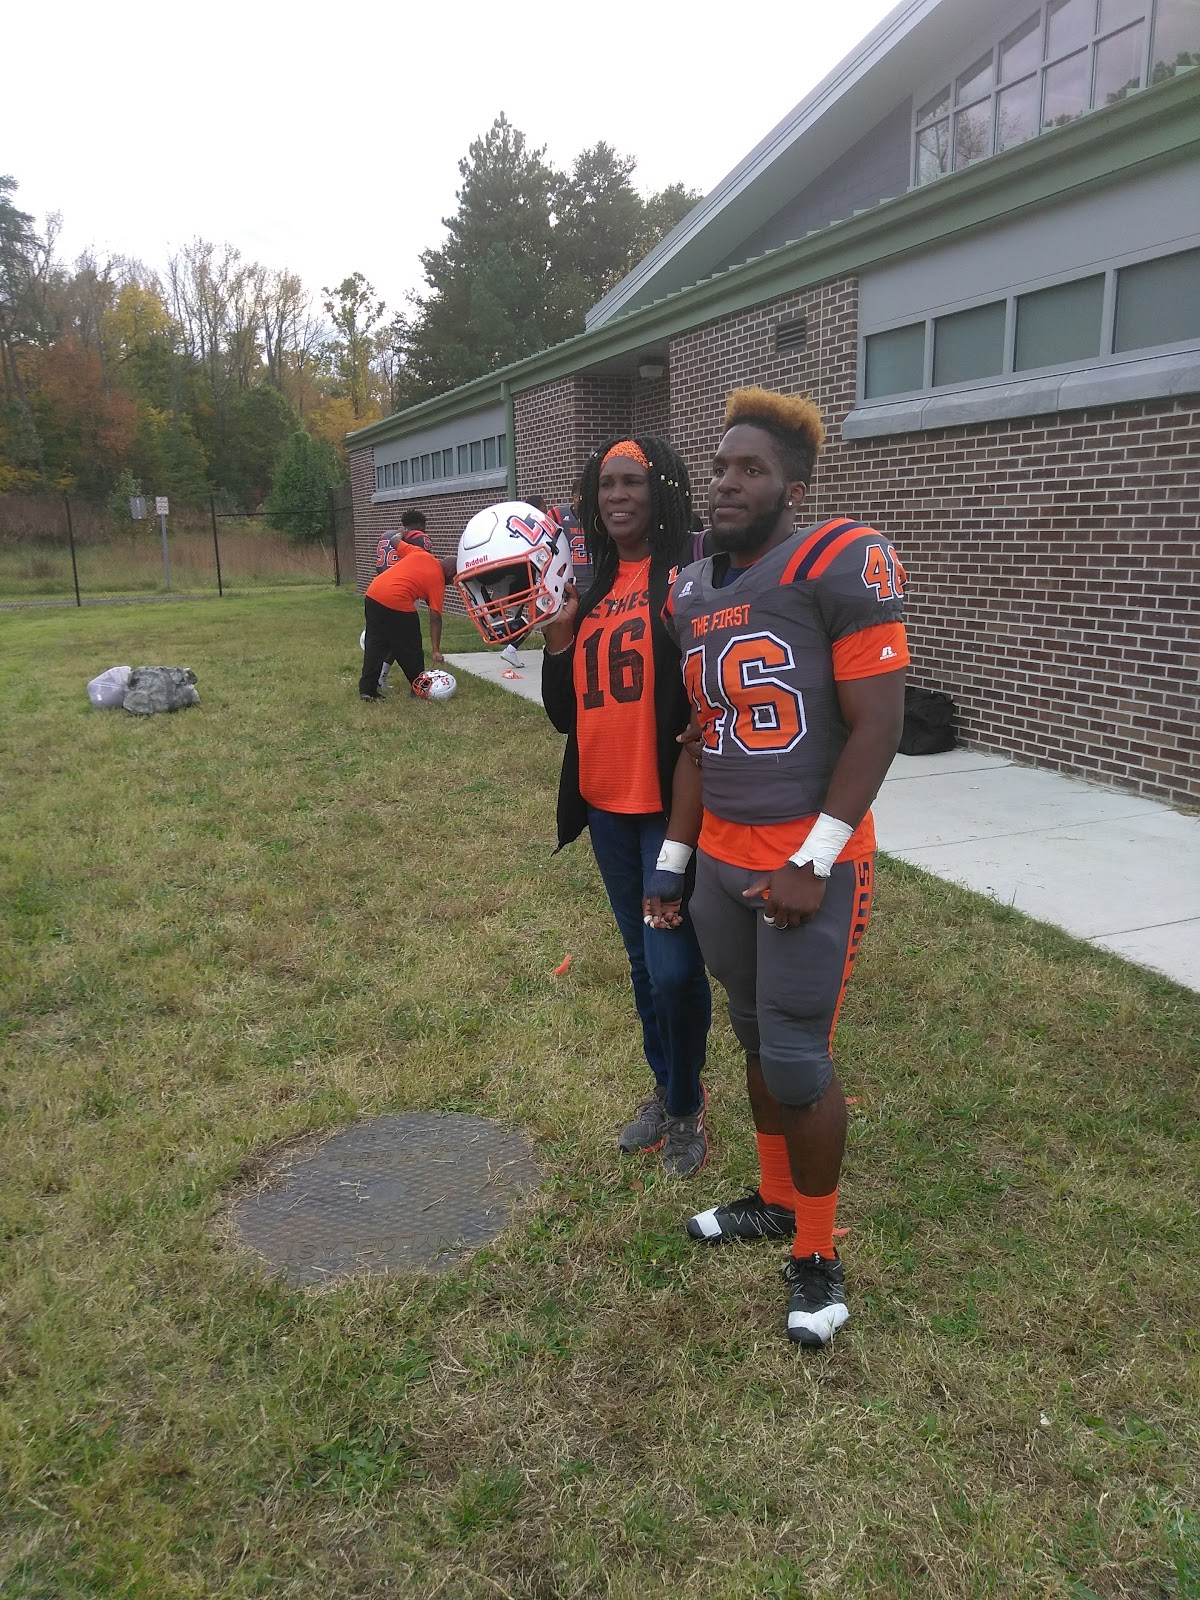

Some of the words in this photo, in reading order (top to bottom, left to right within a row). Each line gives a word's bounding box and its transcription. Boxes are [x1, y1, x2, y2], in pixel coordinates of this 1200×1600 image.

[465, 555, 489, 568] Riddell
[691, 615, 710, 638] THE
[711, 604, 751, 631] FIRST
[582, 616, 647, 711] 16
[682, 630, 807, 755] 46
